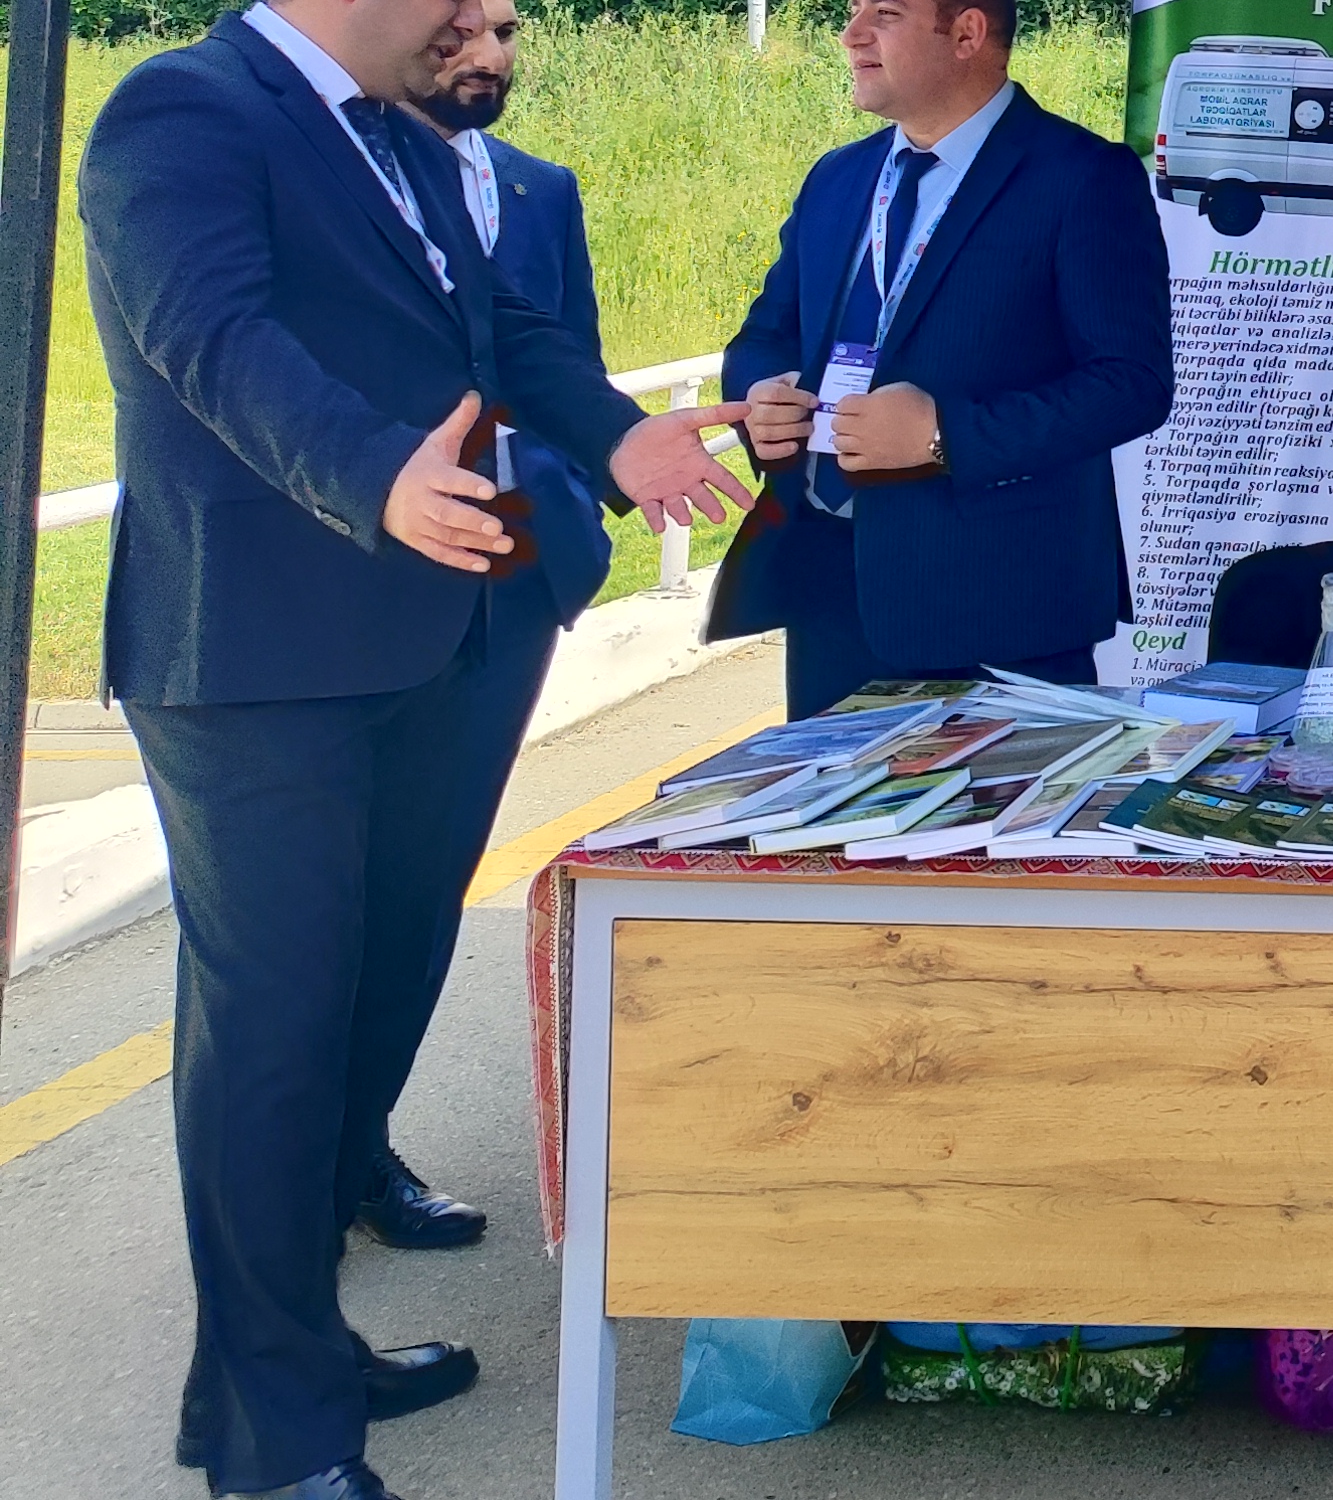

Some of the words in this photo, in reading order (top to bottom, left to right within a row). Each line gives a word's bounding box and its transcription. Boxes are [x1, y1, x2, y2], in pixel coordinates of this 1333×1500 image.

[1229, 294, 1278, 310] ekoloji
[1282, 296, 1322, 310] təmiz
[1189, 308, 1241, 321] təcrübi
[1244, 310, 1304, 324] biliklərə
[1247, 327, 1263, 337] və
[1209, 339, 1284, 354] yerindəcə
[1173, 352, 1245, 369] Torpaqda
[1253, 355, 1287, 370] qida
[1211, 371, 1247, 384] təyin
[1250, 372, 1294, 386] edilir;
[1250, 386, 1312, 401] ehtiyacı
[1216, 401, 1257, 413] edilir
[1260, 403, 1320, 419] (torpağı
[1198, 416, 1263, 432] vəziyyəti
[1264, 418, 1313, 432] tənzim
[1169, 429, 1238, 446] Torpağın
[1247, 433, 1322, 450] aqrofiziki
[1145, 444, 1193, 457] tərkibi
[1196, 445, 1232, 459] təyin
[1235, 447, 1279, 462] edilir;
[1160, 459, 1211, 475] Torpaq
[1213, 462, 1272, 477] mühitin
[1166, 475, 1240, 492] Torpaqda
[1248, 480, 1320, 496] şorlaşma
[1142, 491, 1263, 509] qiymətləndirilir;
[1161, 503, 1236, 522] İrriqasiya
[1244, 511, 1329, 526] eroziyasına
[1140, 519, 1195, 536] olunur;
[1155, 535, 1201, 551] Sudan
[1137, 550, 1211, 567] sistemləri
[1136, 582, 1207, 599] tövsiyələr
[1134, 613, 1173, 629] təşkil
[1133, 630, 1187, 654] Qeyd
